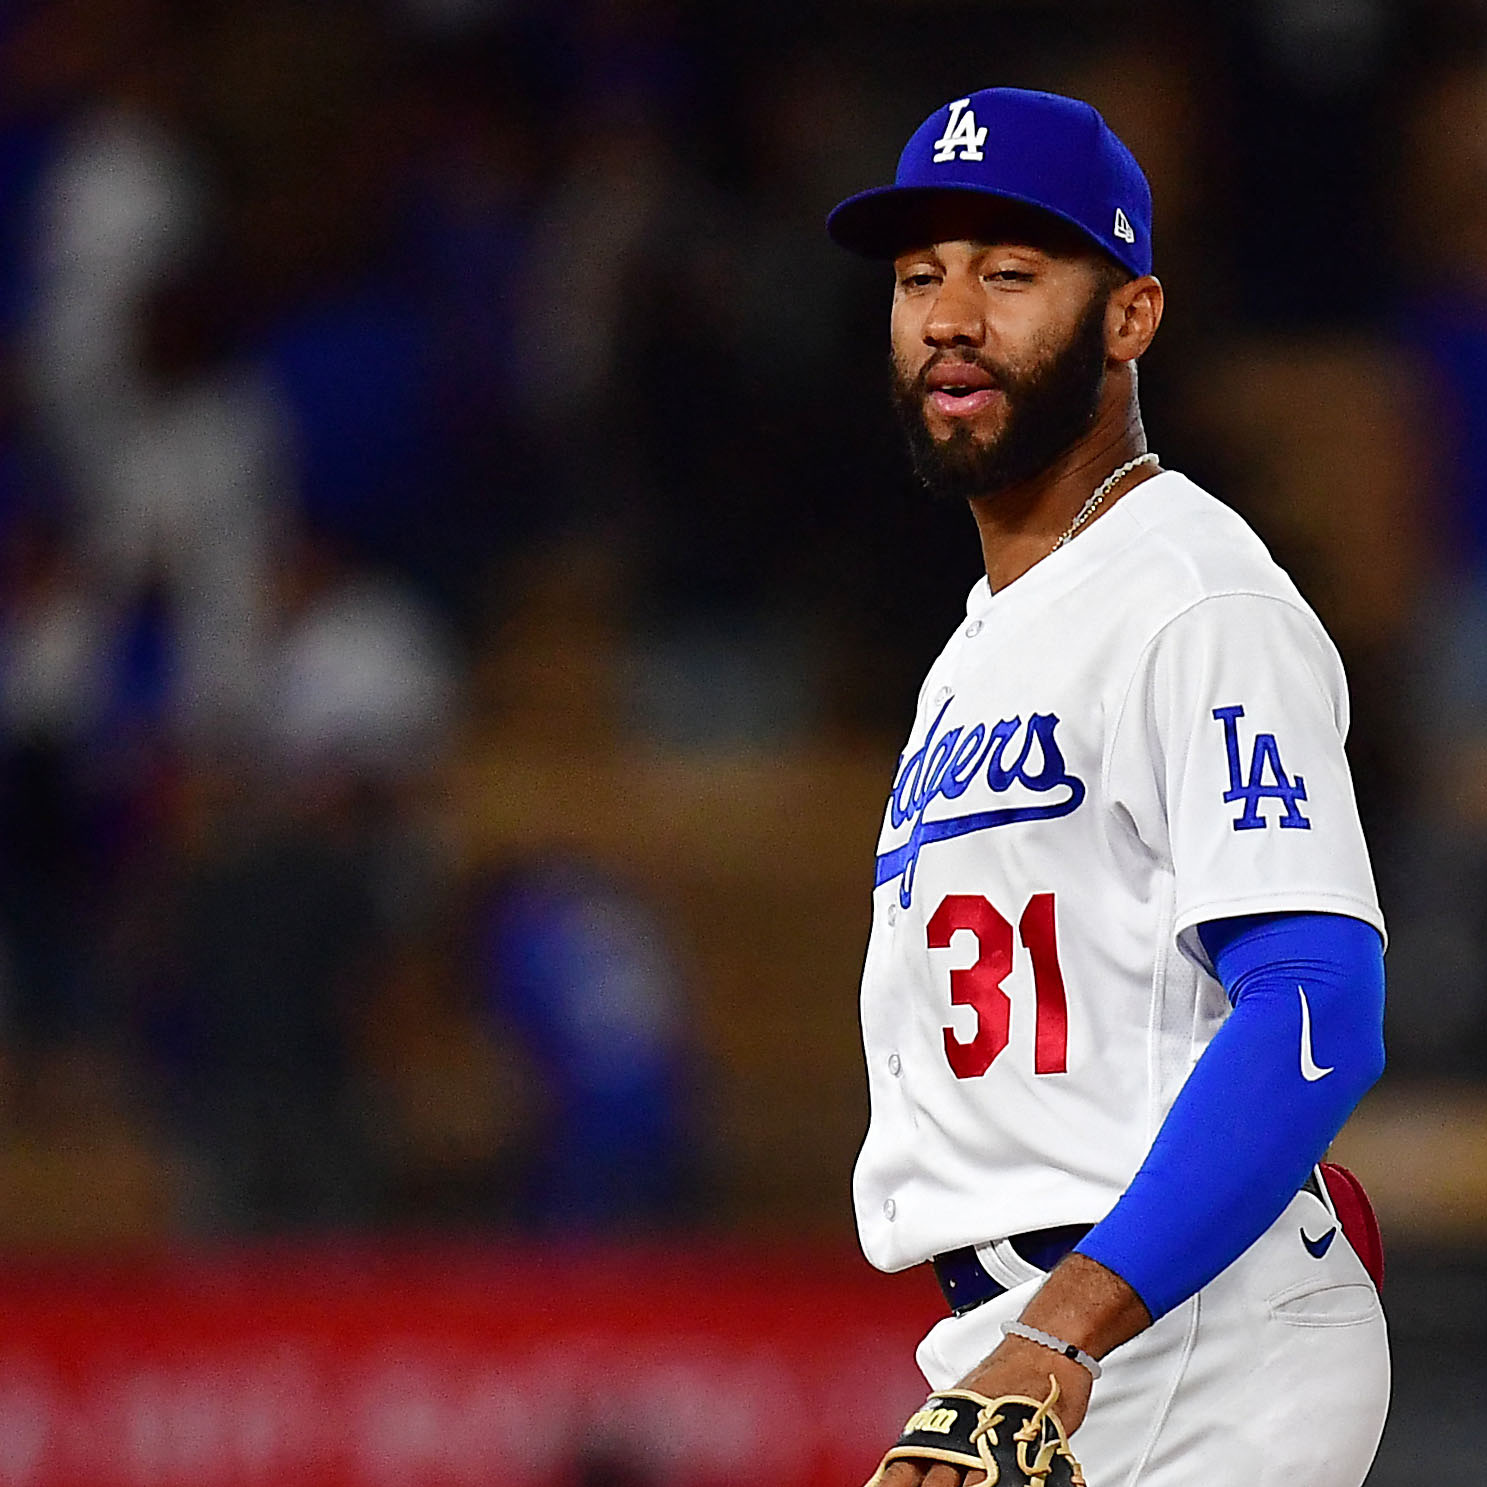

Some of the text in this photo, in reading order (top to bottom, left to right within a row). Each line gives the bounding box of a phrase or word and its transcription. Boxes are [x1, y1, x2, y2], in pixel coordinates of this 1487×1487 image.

[933, 98, 988, 163] LA
[875, 695, 1086, 909] dgers
[1212, 705, 1312, 831] LA
[926, 892, 1069, 1080] 31
